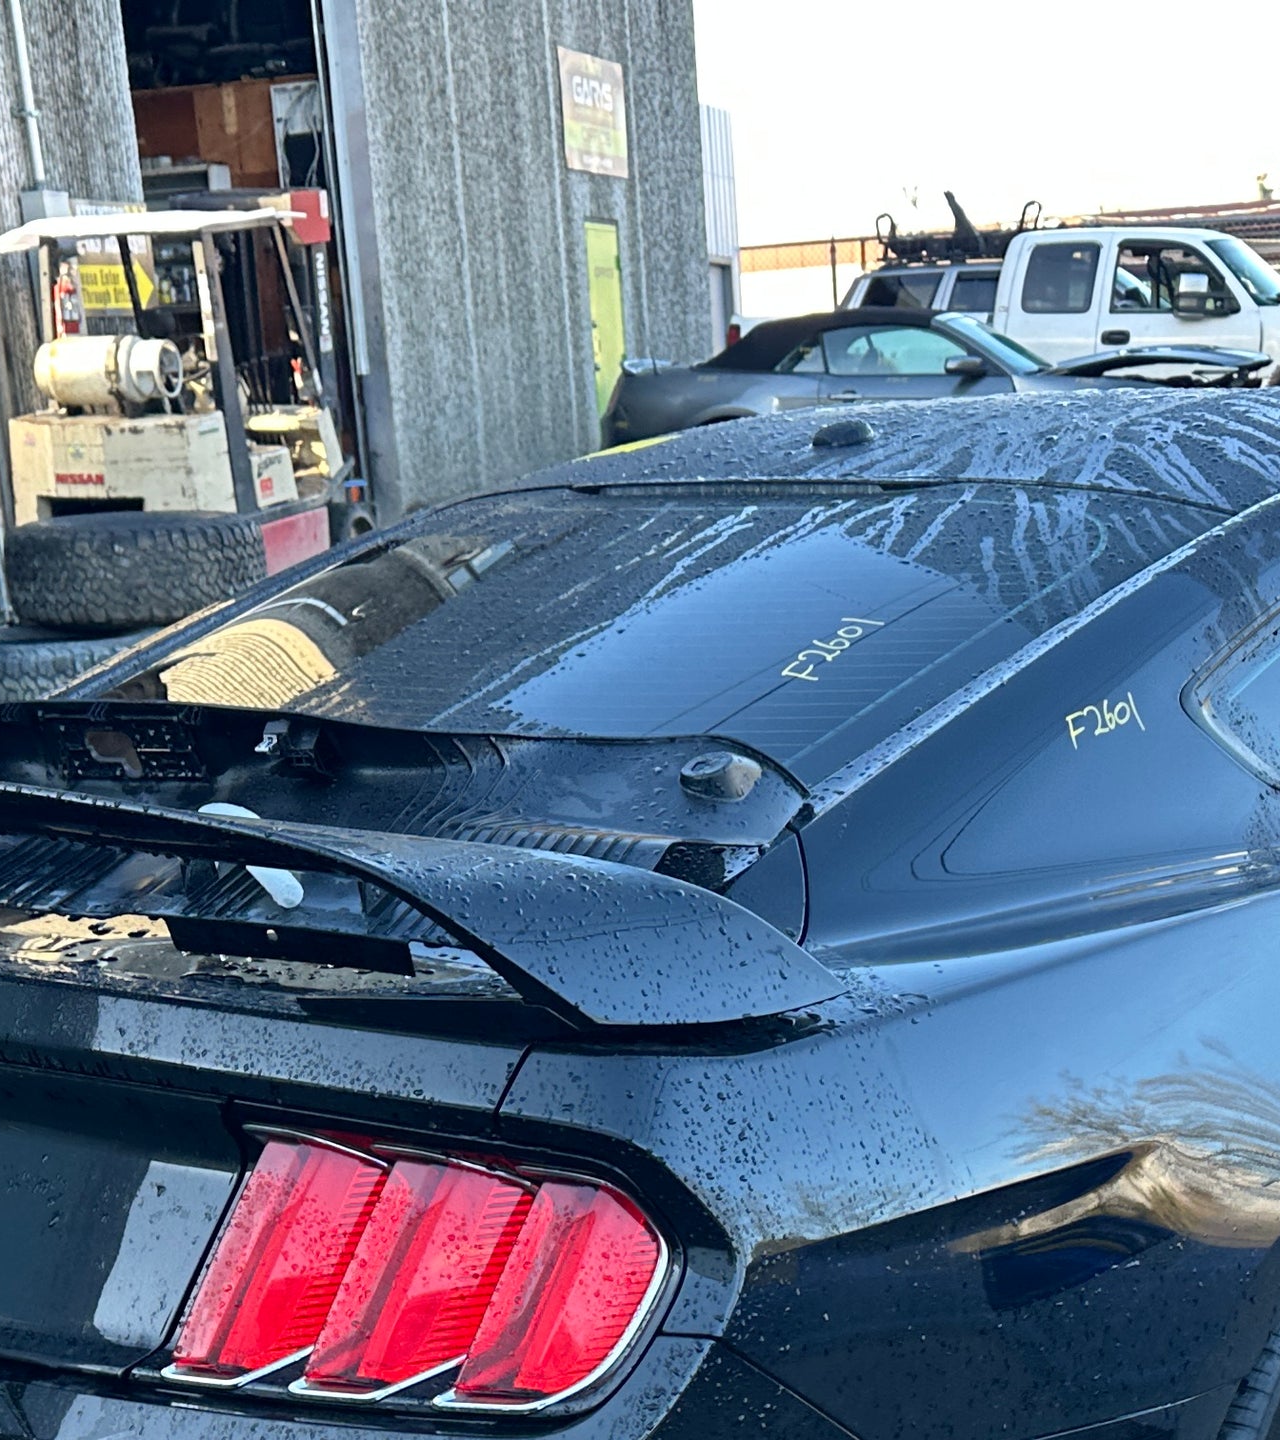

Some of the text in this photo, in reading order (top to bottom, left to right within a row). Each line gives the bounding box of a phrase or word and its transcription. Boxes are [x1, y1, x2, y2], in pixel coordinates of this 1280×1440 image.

[54, 472, 104, 486] NISSAN
[781, 617, 885, 681] F2601
[1065, 691, 1145, 750] F2601
